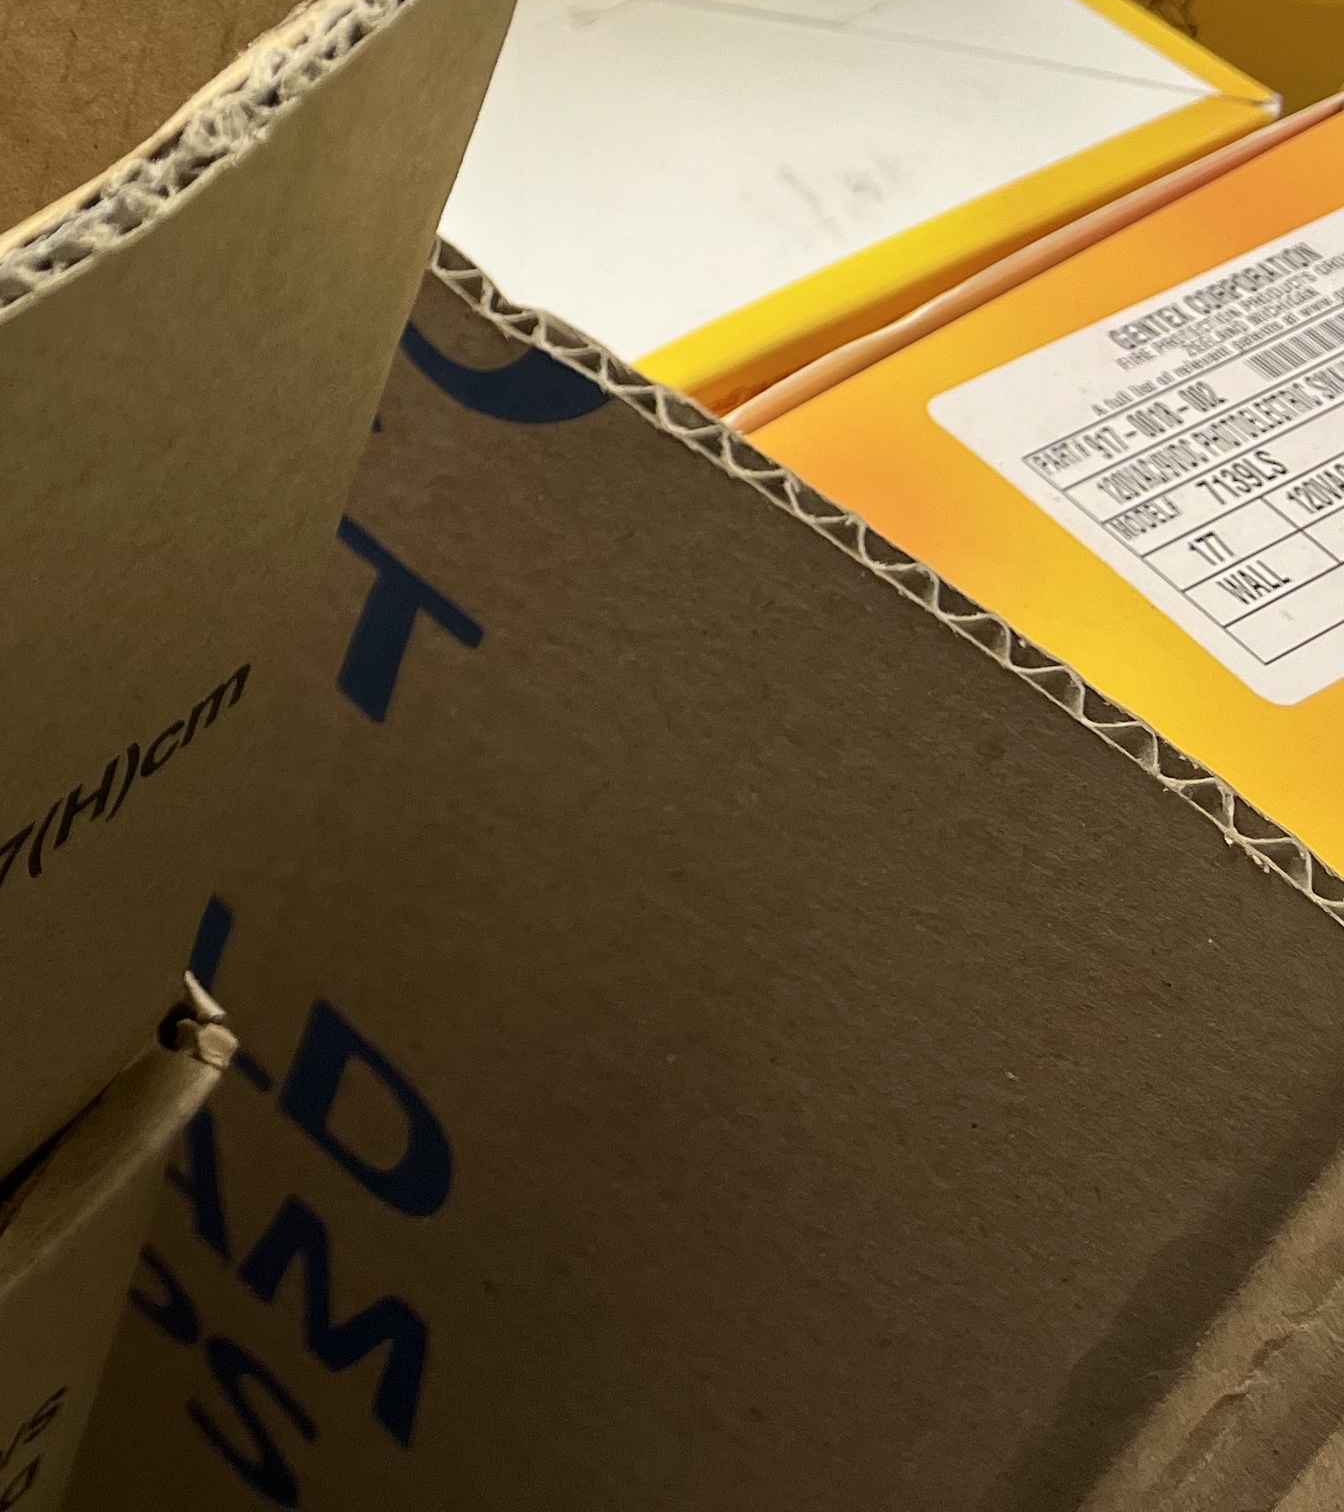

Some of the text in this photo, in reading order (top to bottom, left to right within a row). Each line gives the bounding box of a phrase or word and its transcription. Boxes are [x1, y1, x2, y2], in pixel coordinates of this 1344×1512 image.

[1106, 241, 1322, 351] GENTEX CORPORATION
[1196, 449, 1289, 506] 7139LS
[1188, 531, 1236, 568] 177
[1216, 559, 1294, 605] WALL
